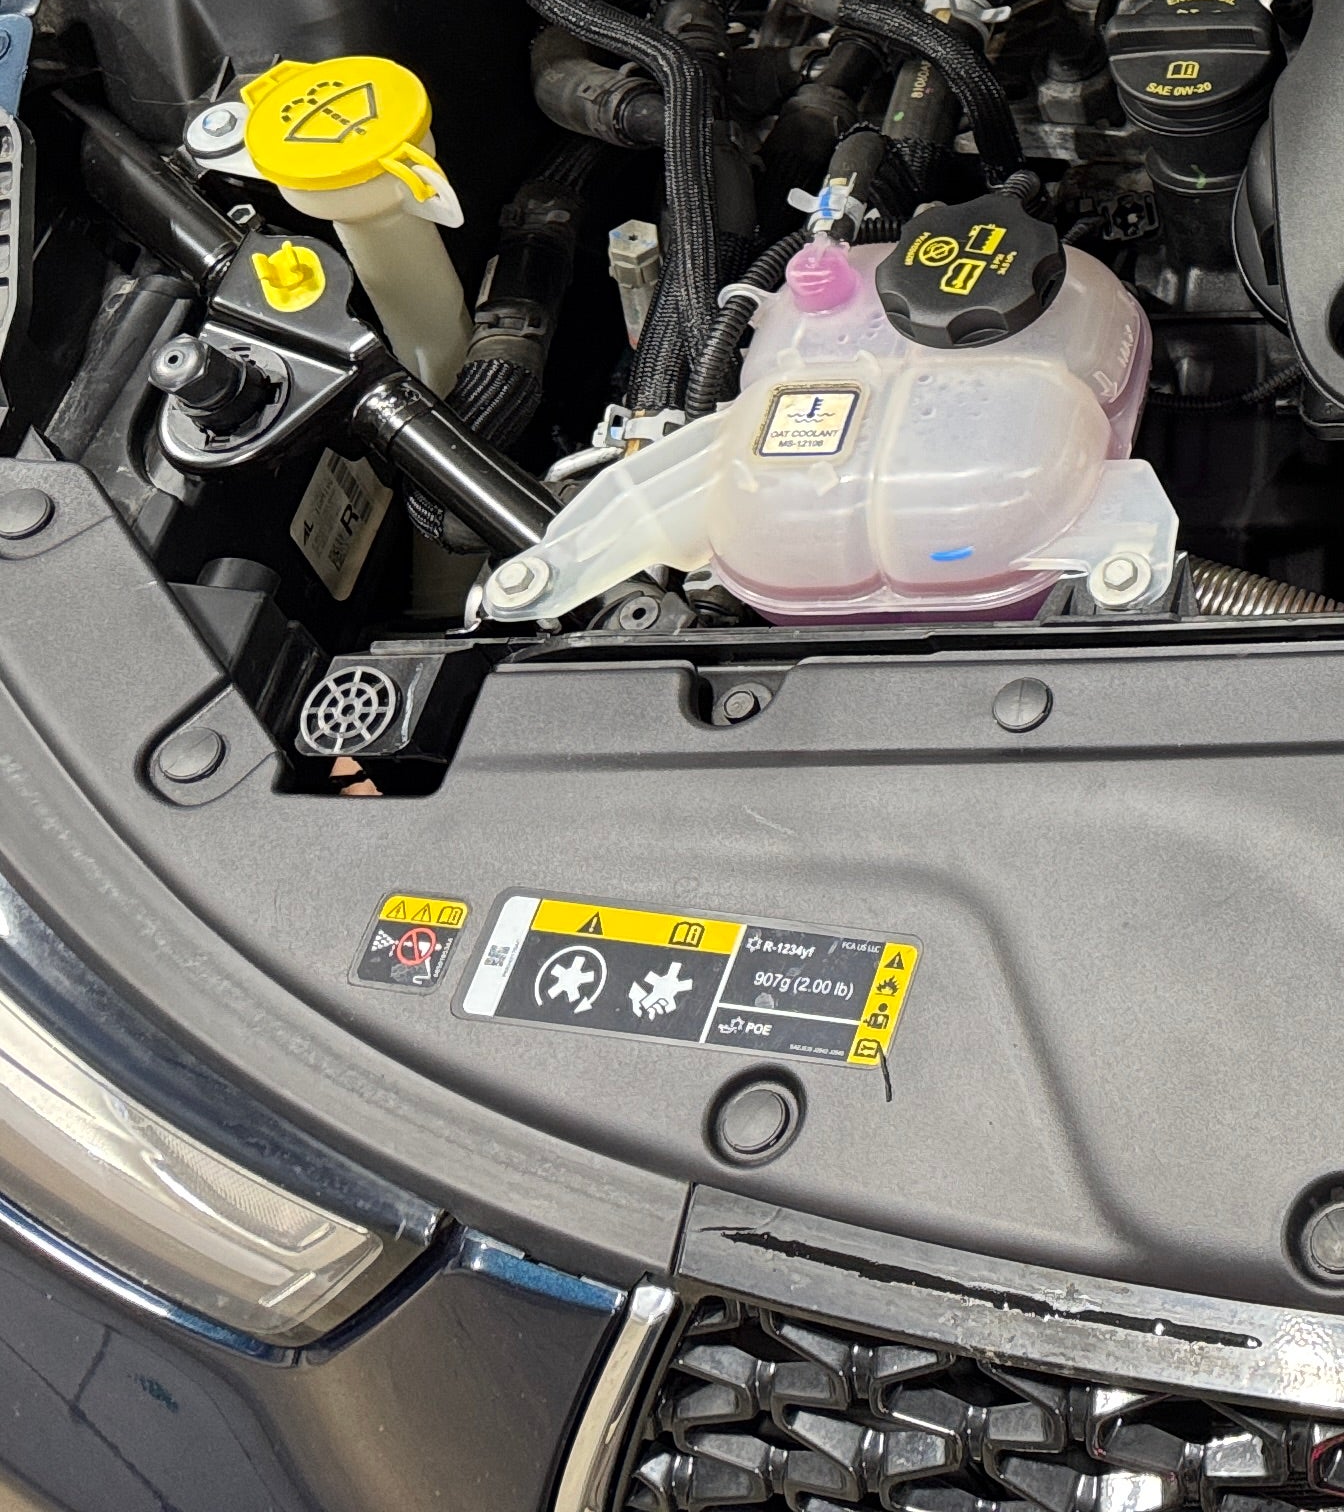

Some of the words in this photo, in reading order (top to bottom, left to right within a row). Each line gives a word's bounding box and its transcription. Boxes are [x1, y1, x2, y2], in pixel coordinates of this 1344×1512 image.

[1145, 82, 1172, 96] SAE
[1173, 81, 1213, 96] 0W-20
[770, 430, 790, 439] OAT
[790, 429, 840, 439] COOLANT
[340, 503, 360, 537] R
[762, 942, 816, 960] R-1234yf
[841, 940, 857, 951] FCA
[753, 971, 791, 993] 907g
[793, 976, 832, 996] (2.00
[833, 981, 855, 1001] lb)
[745, 1022, 774, 1037] POE
